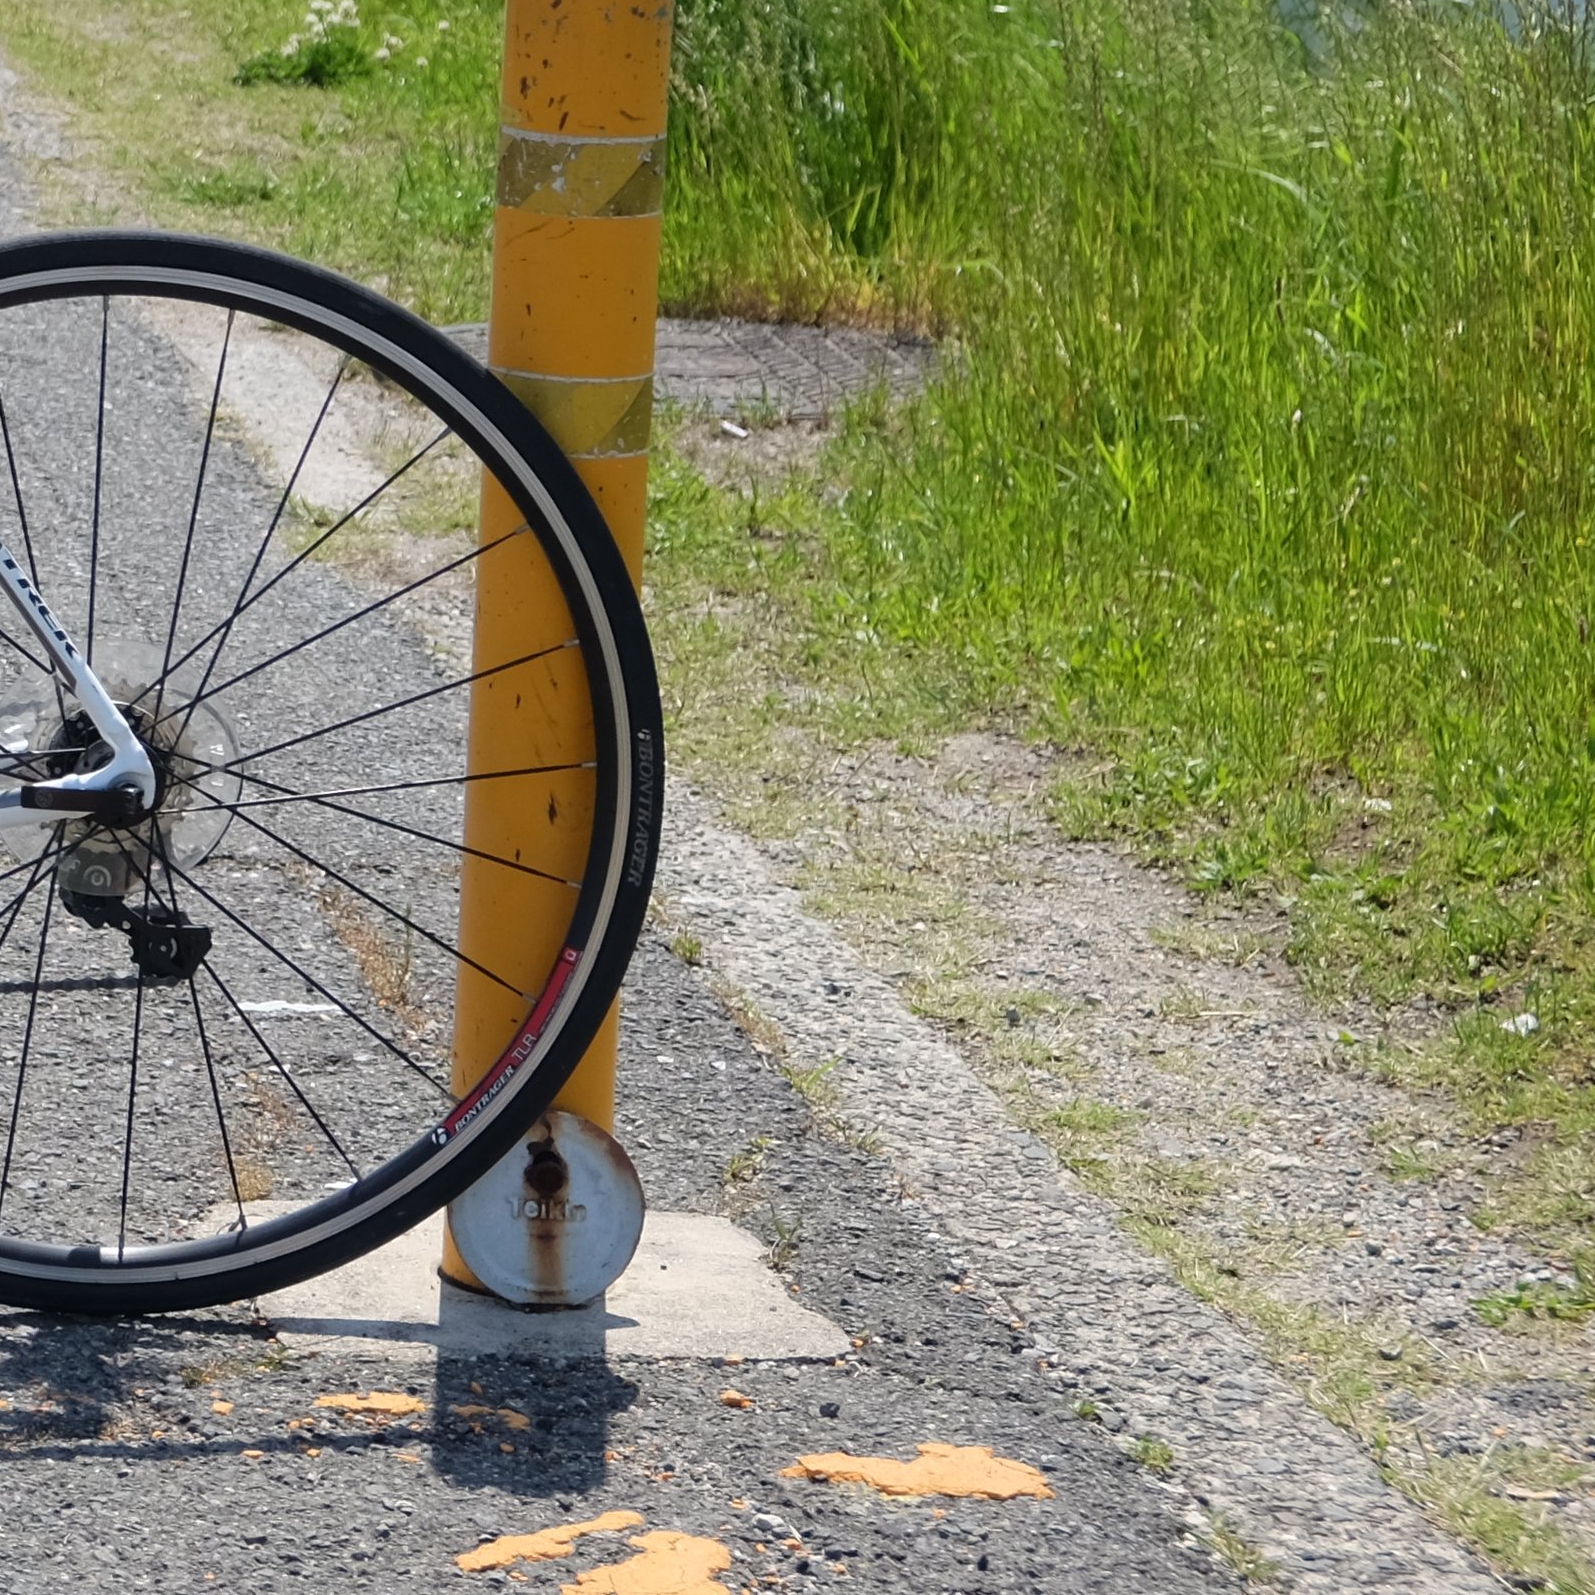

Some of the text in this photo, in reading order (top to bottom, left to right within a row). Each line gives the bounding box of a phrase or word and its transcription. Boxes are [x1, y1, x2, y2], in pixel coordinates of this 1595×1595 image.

[3, 558, 81, 659] TREK
[625, 741, 659, 891] BONTRAGER
[454, 1032, 537, 1133] BONTRAGER TLR
